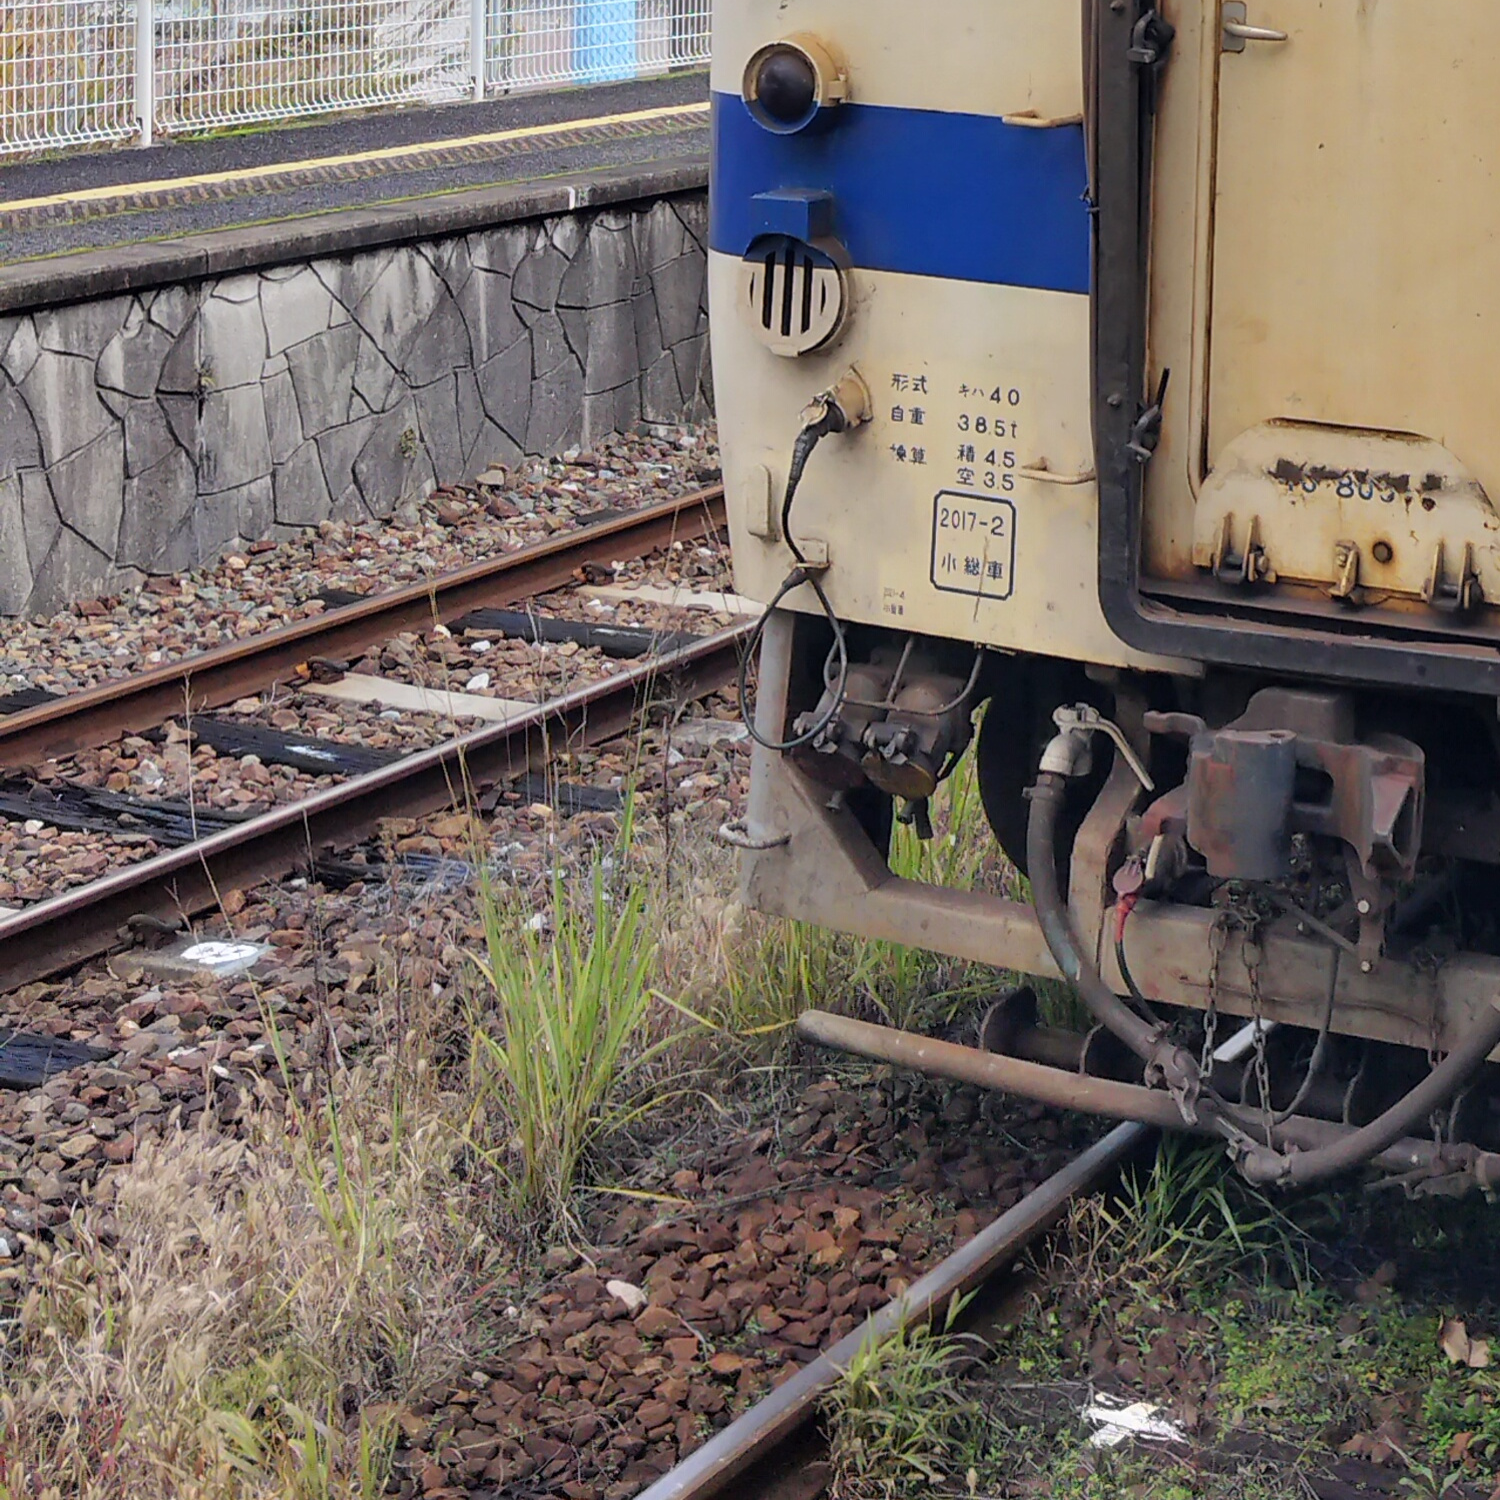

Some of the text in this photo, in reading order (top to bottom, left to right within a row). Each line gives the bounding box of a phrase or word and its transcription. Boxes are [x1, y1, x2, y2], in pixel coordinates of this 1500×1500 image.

[891, 373, 928, 395] 形式
[891, 405, 1018, 439] 自重 38.5t
[940, 508, 1005, 537] 2017-2
